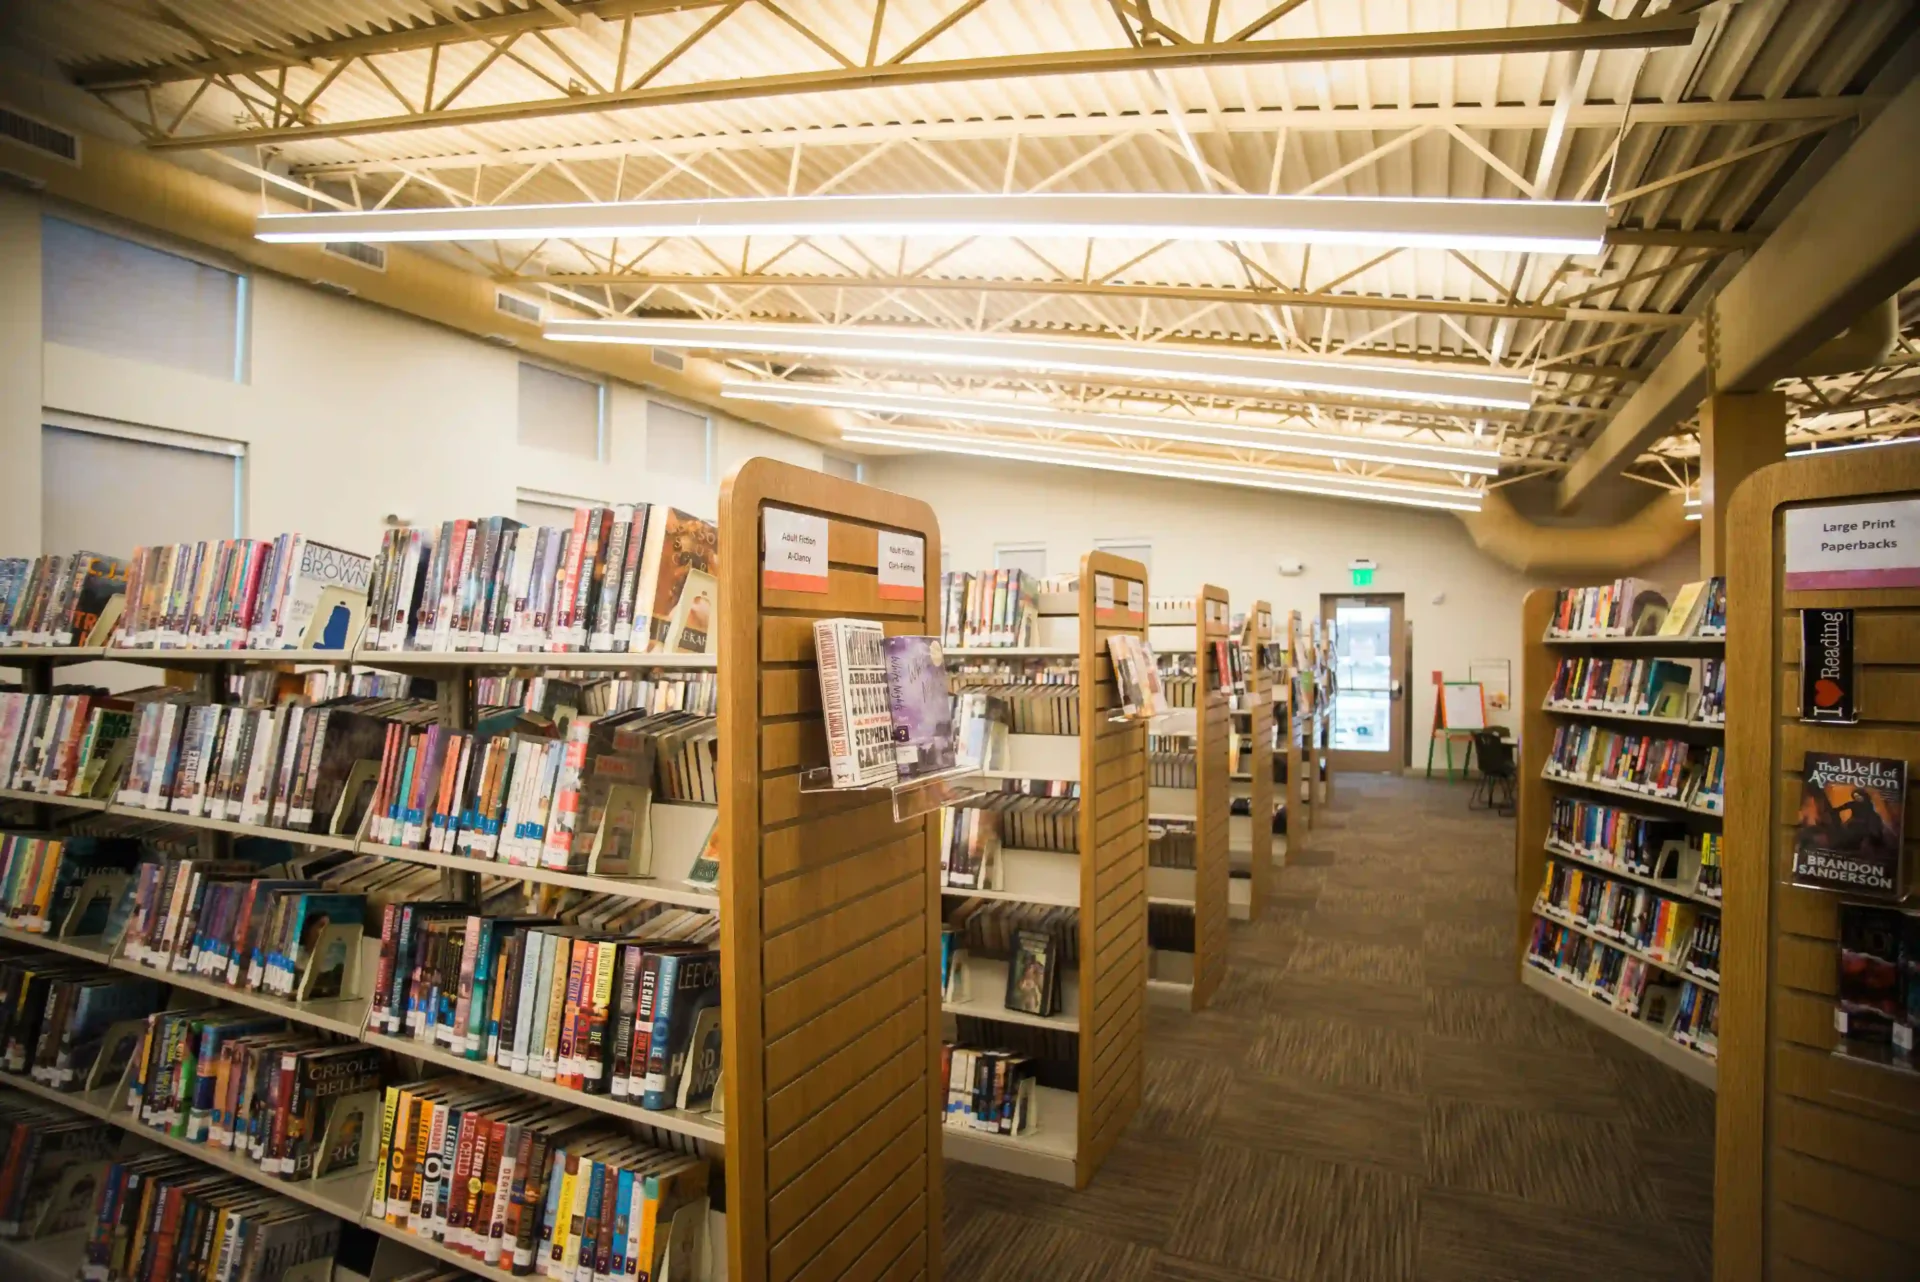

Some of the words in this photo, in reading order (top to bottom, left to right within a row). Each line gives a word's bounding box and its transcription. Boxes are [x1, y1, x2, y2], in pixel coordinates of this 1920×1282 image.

[1822, 521, 1859, 534] Large
[1861, 518, 1897, 531] Print
[782, 532, 798, 543] Adult
[799, 534, 817, 547] Fiction
[1820, 538, 1898, 554] Paperbacks
[304, 543, 334, 563] RITA
[339, 554, 371, 574] MAE
[300, 557, 369, 587] BROWN
[1820, 611, 1844, 679] Reading
[891, 684, 906, 711] Nights
[1813, 705, 1843, 717] I
[828, 711, 846, 738] LINCOLN
[856, 725, 889, 746] STEPHEN
[1808, 769, 1899, 789] Ascension
[1816, 761, 1840, 772] The
[1839, 758, 1881, 776] Well
[1883, 768, 1899, 779] of
[1799, 864, 1892, 889] SANDERSON
[1807, 855, 1884, 877] BRANDON
[572, 960, 582, 976] LEE
[598, 947, 612, 977] LINCOLN
[643, 970, 656, 987] LEE
[660, 973, 673, 996] HARD
[678, 962, 700, 990] LEE
[568, 977, 581, 1002] CHILD
[596, 978, 609, 999] CHILD
[640, 988, 654, 1016] CHILD
[659, 996, 669, 1016] WAY
[617, 1015, 631, 1058] FORGOTTEN
[310, 1057, 379, 1081] CREOLE
[315, 1074, 373, 1097] BELLE
[384, 1104, 394, 1121] LEE
[381, 1121, 392, 1146] CHILD
[418, 1118, 428, 1134] LEE
[430, 1109, 444, 1152] PERSUADER
[446, 1124, 456, 1140] LEE
[462, 1117, 476, 1140] LEE
[416, 1135, 427, 1160] CHILD
[443, 1140, 455, 1165] CHILD
[476, 1135, 487, 1152] LEE
[457, 1141, 473, 1177] CHILD
[472, 1153, 485, 1178] CHILD
[424, 1184, 434, 1198] LEE
[500, 1167, 512, 1200] DEATH
